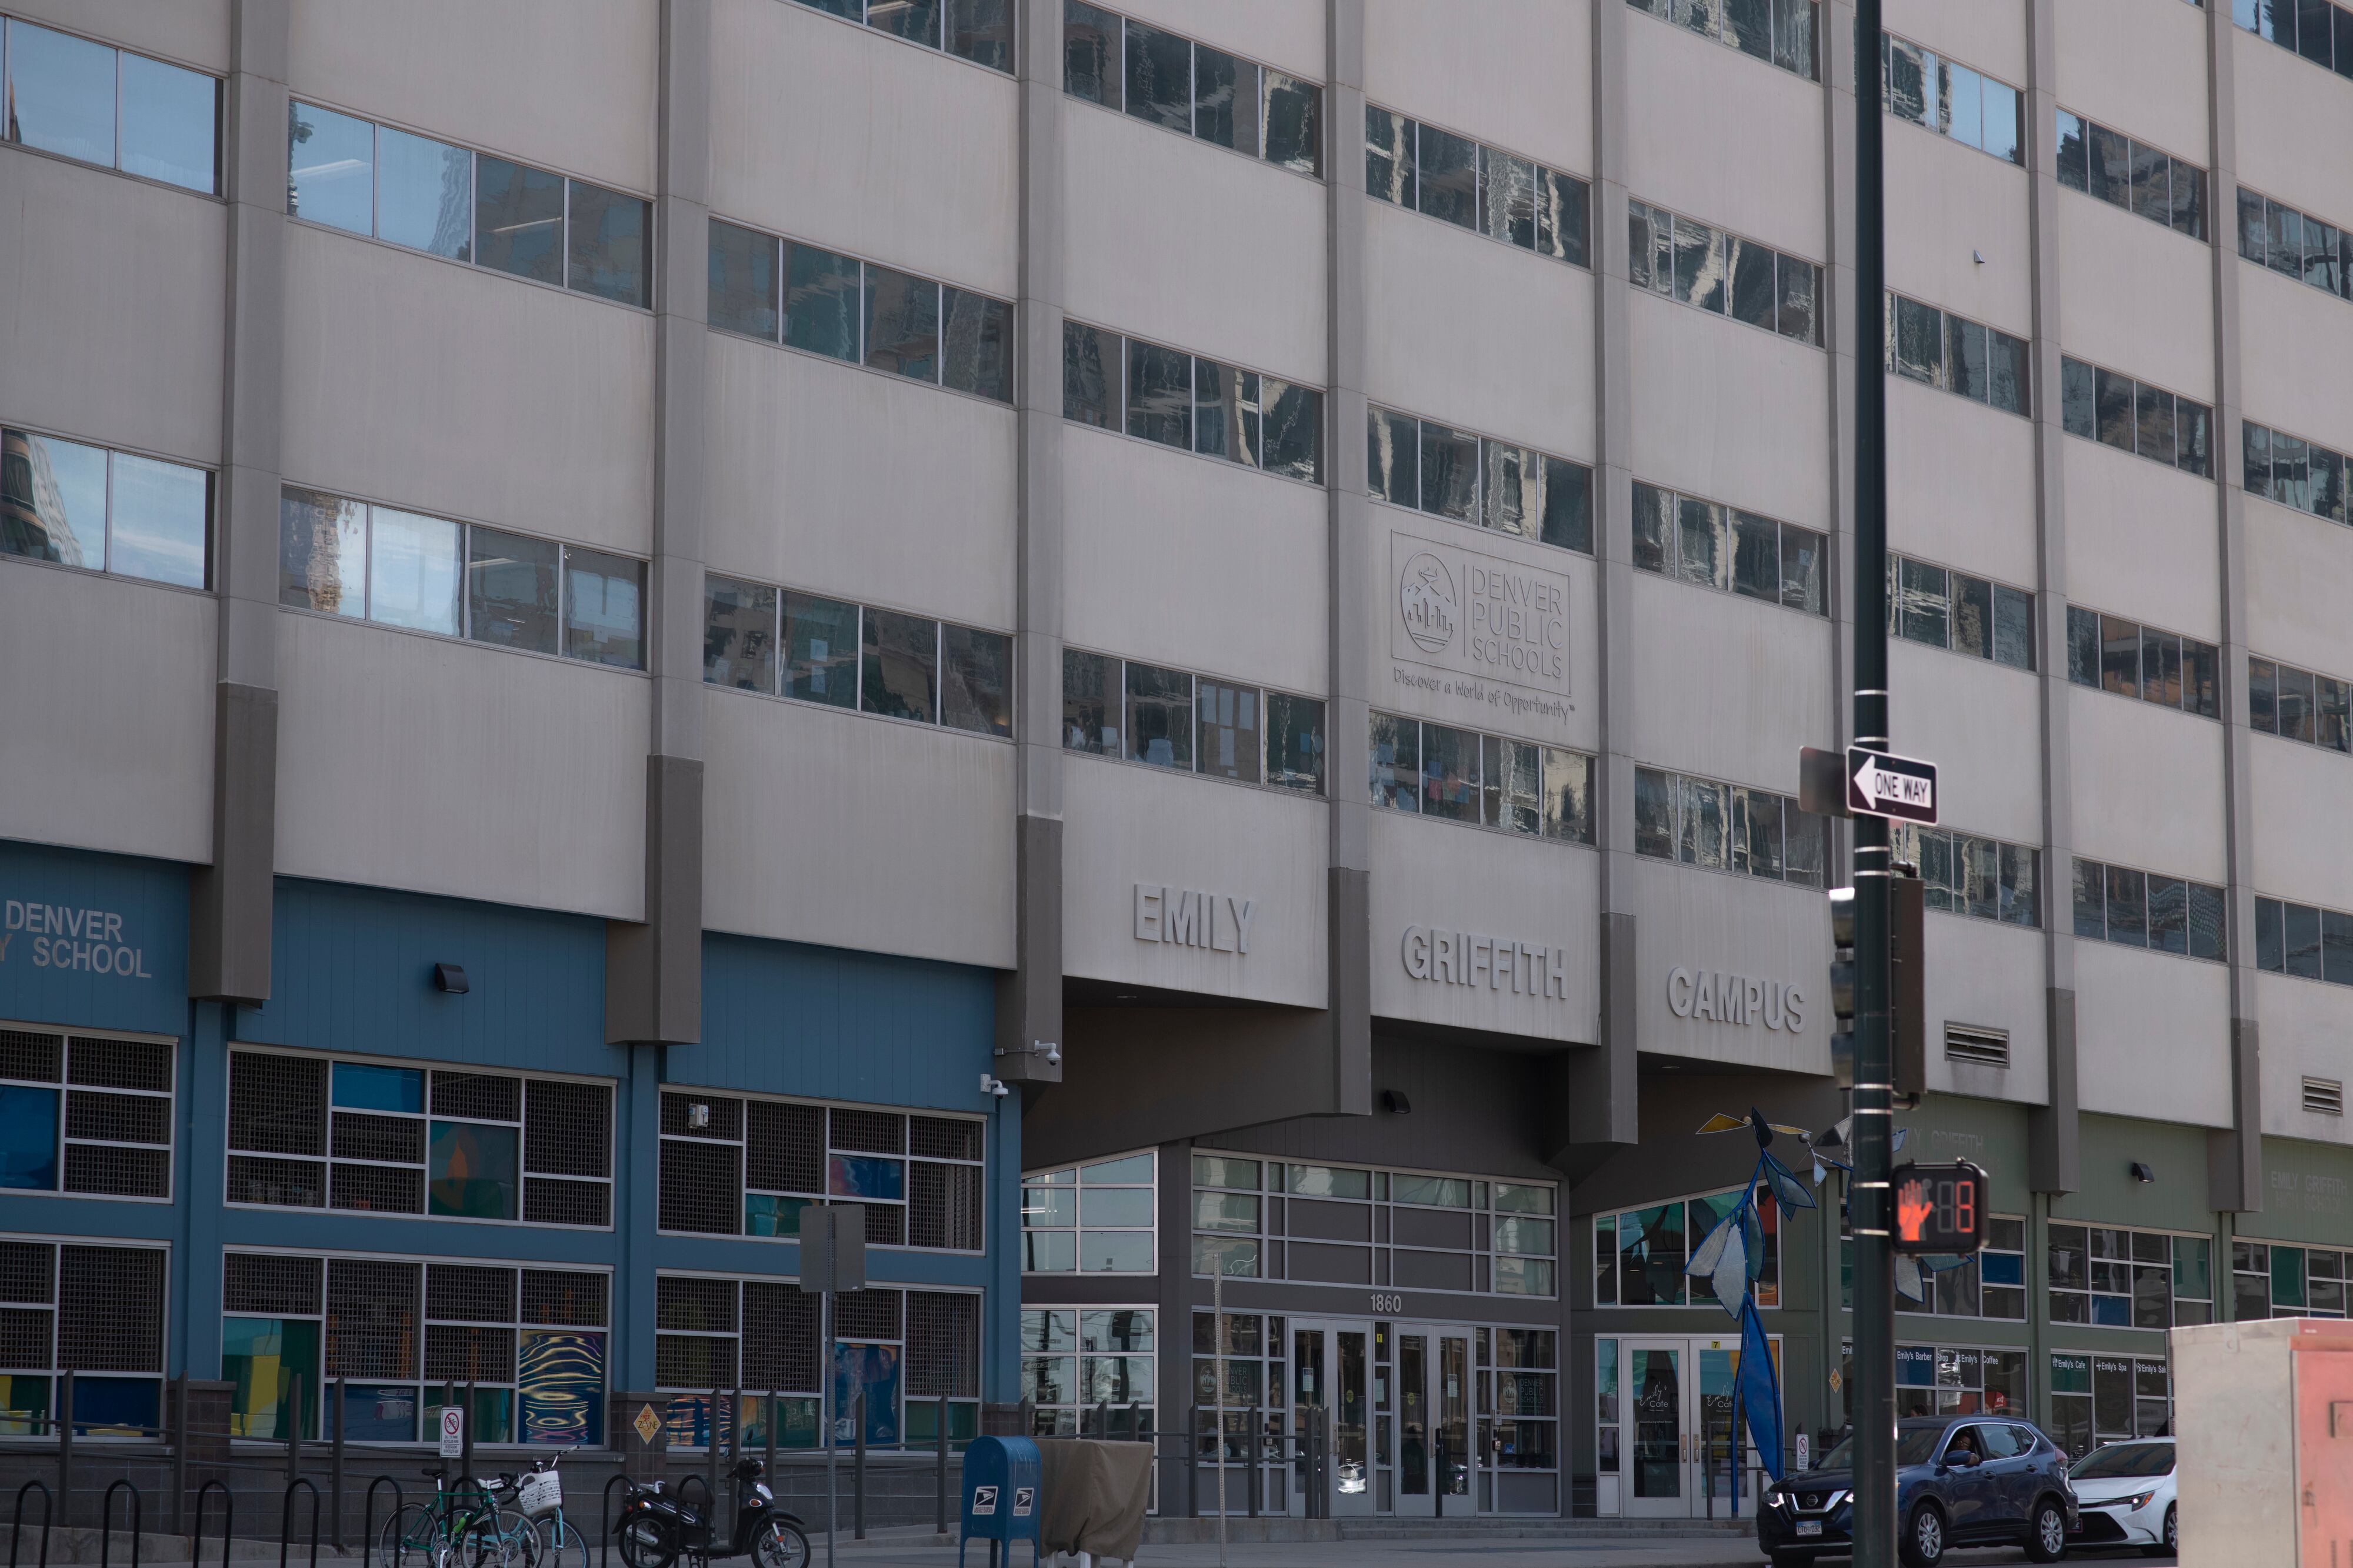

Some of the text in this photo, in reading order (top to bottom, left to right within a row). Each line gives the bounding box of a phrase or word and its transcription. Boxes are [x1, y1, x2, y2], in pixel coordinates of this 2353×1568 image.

[1472, 565, 1562, 615] DENVER
[1473, 599, 1562, 649] PUBLIC
[1473, 636, 1562, 679] SCHOOLS
[1394, 666, 1441, 691] Discover
[1445, 682, 1451, 693] a
[1455, 680, 1484, 700] World
[1488, 690, 1501, 706] of
[1875, 772, 1928, 803] ONE WAY
[5, 900, 123, 943] DENVER
[1134, 883, 1257, 954] EMILY
[32, 936, 152, 979] SCHOOL
[1401, 925, 1568, 999] GRIFFITH
[1667, 966, 1807, 1033] CAMPUS
[2271, 1170, 2348, 1196] EMILY GRIFFITH
[1370, 1294, 1402, 1313] 1860
[1897, 1351, 1949, 1363] Emily's Barber Shop
[1961, 1355, 1999, 1365] Emily's Coffee
[2058, 1359, 2086, 1370] Emily's Cafe
[2101, 1362, 2127, 1373] Emily's Spa
[2142, 1365, 2157, 1374] Emily's
[1520, 1378, 1544, 1387] DENVER
[1520, 1387, 1544, 1396] PUBLIC
[1639, 1381, 1668, 1406] Emily's
[638, 1420, 658, 1431] ZONE
